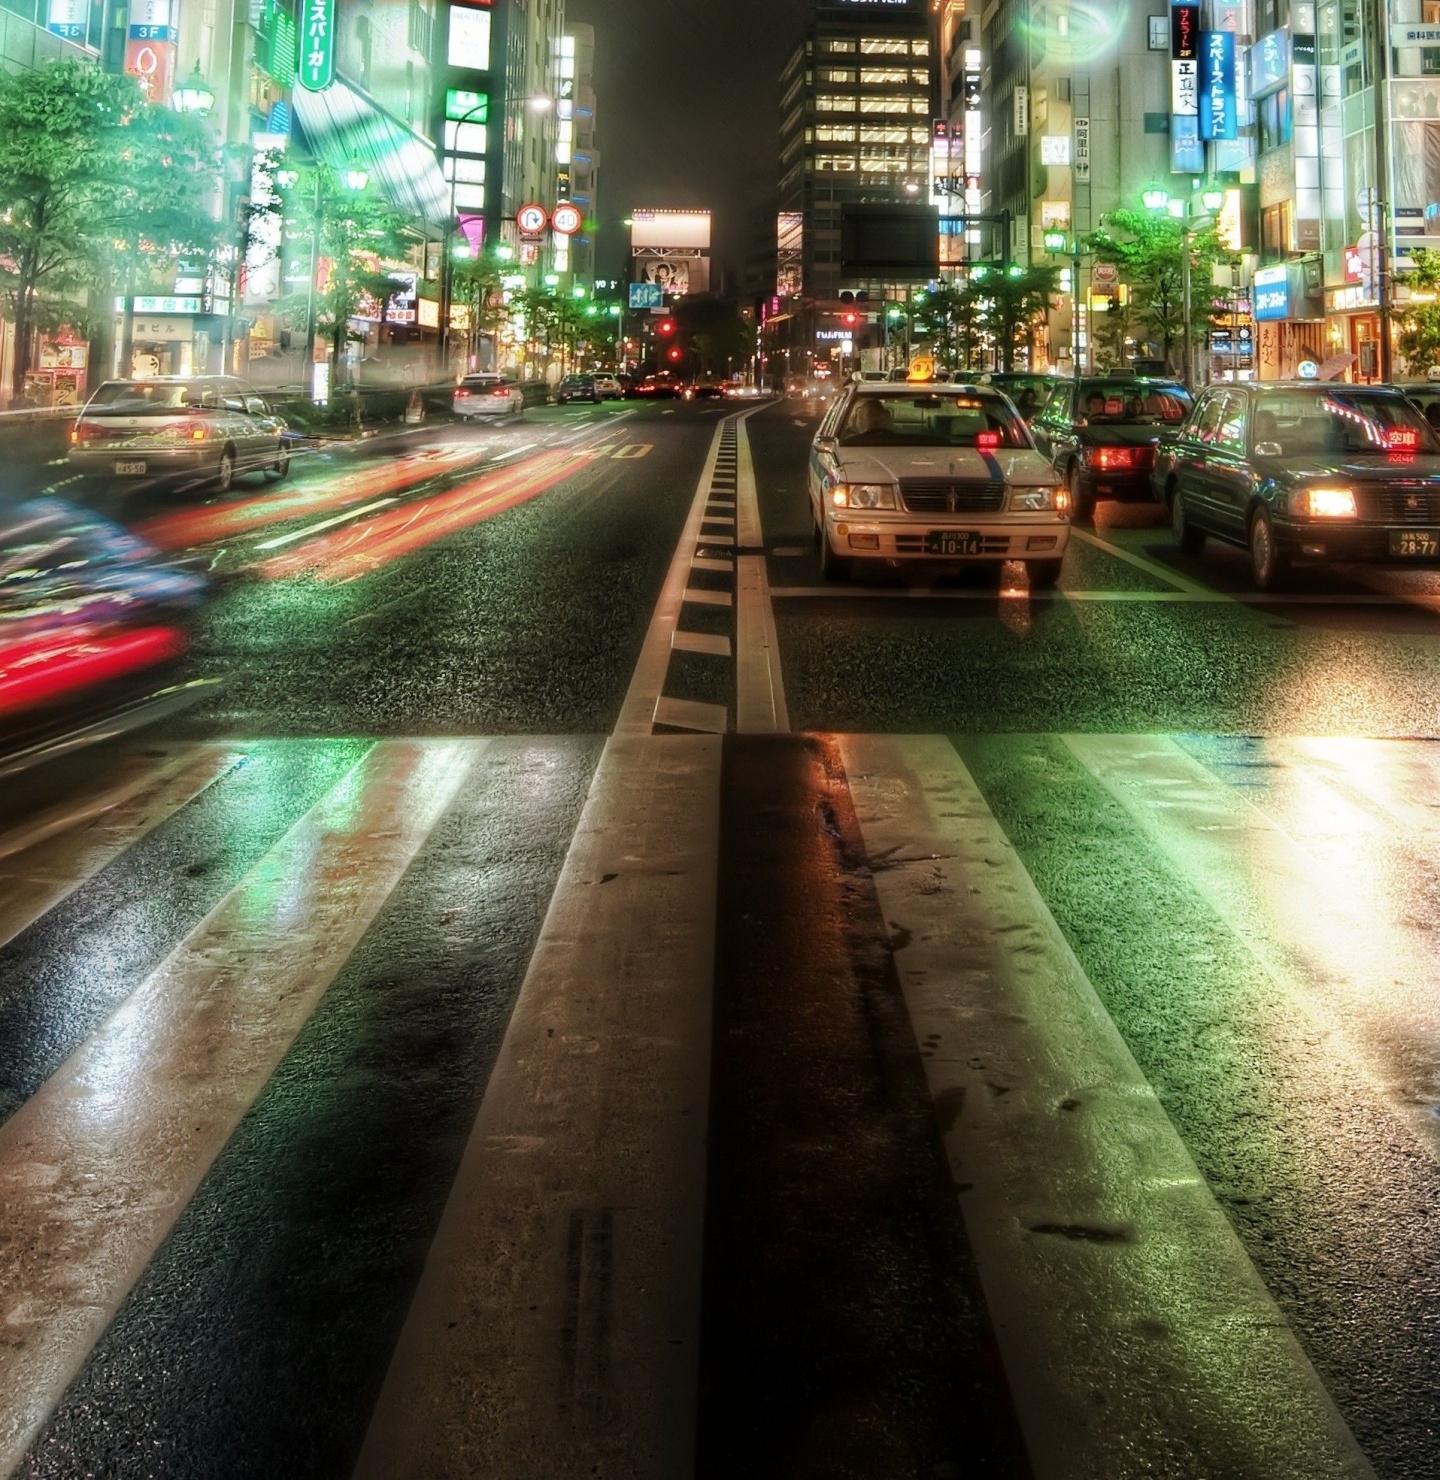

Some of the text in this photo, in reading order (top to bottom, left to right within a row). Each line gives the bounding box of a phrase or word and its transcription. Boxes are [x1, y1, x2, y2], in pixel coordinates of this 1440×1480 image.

[139, 27, 160, 38] 3F
[1181, 9, 1190, 48] サムラート
[1210, 35, 1226, 137] スペーストラスト
[1077, 129, 1088, 158] 阿里山
[558, 214, 575, 227] 40
[816, 331, 852, 339] FUJIFILM
[1389, 432, 1415, 445] 空車
[942, 540, 977, 554] 10-14
[1400, 541, 1437, 555] 28-77
